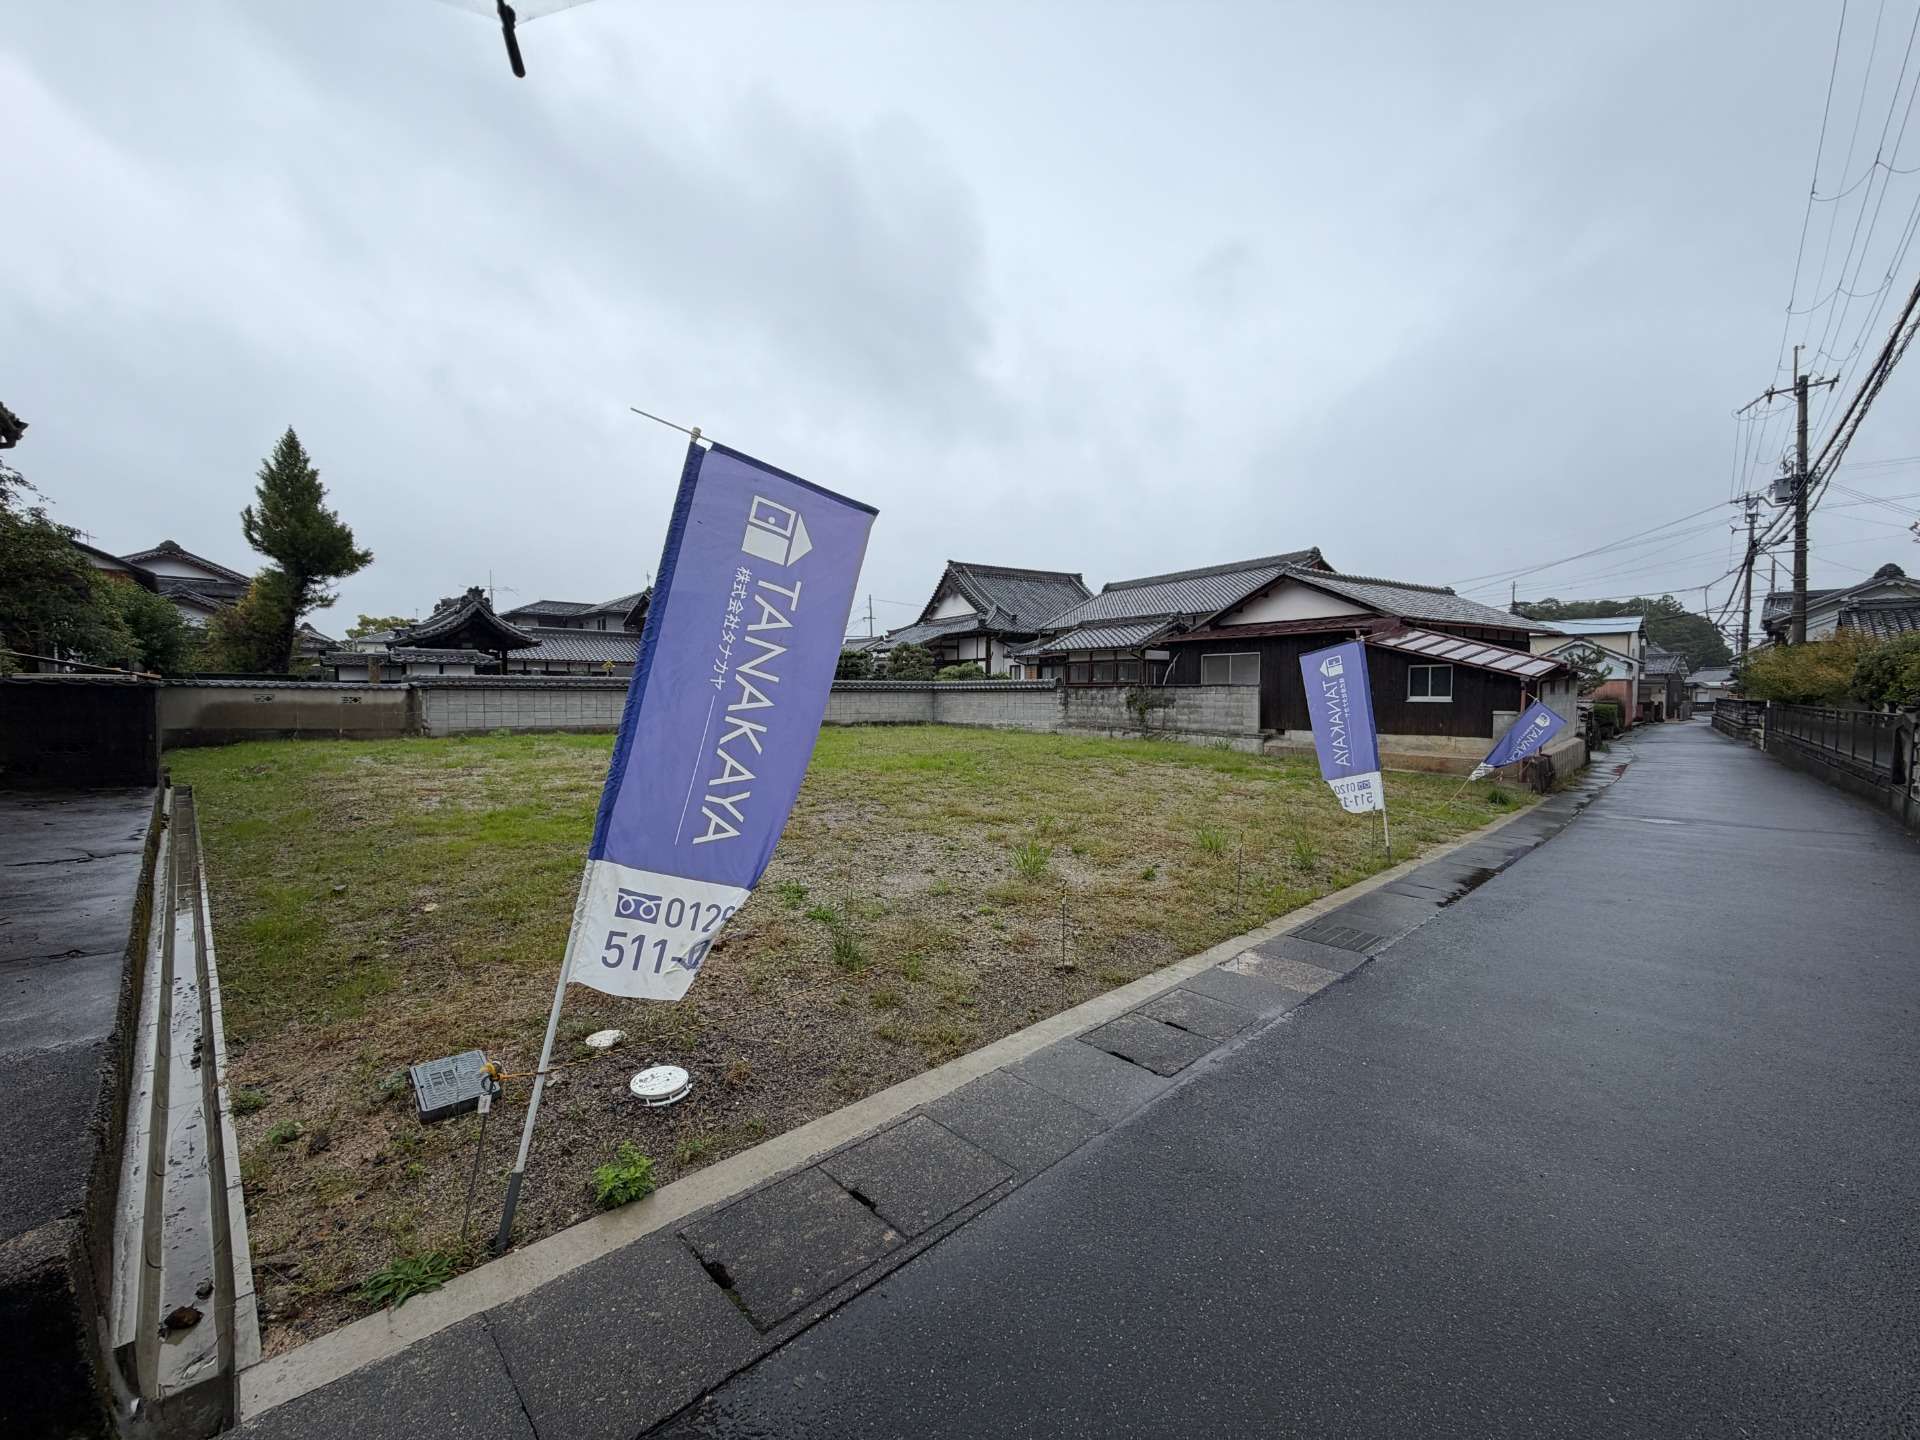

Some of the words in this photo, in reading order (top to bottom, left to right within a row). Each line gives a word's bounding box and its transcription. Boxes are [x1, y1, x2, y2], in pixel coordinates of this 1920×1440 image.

[692, 580, 802, 844] TANAKAYA
[710, 566, 752, 690] 株式会社タナカヤ
